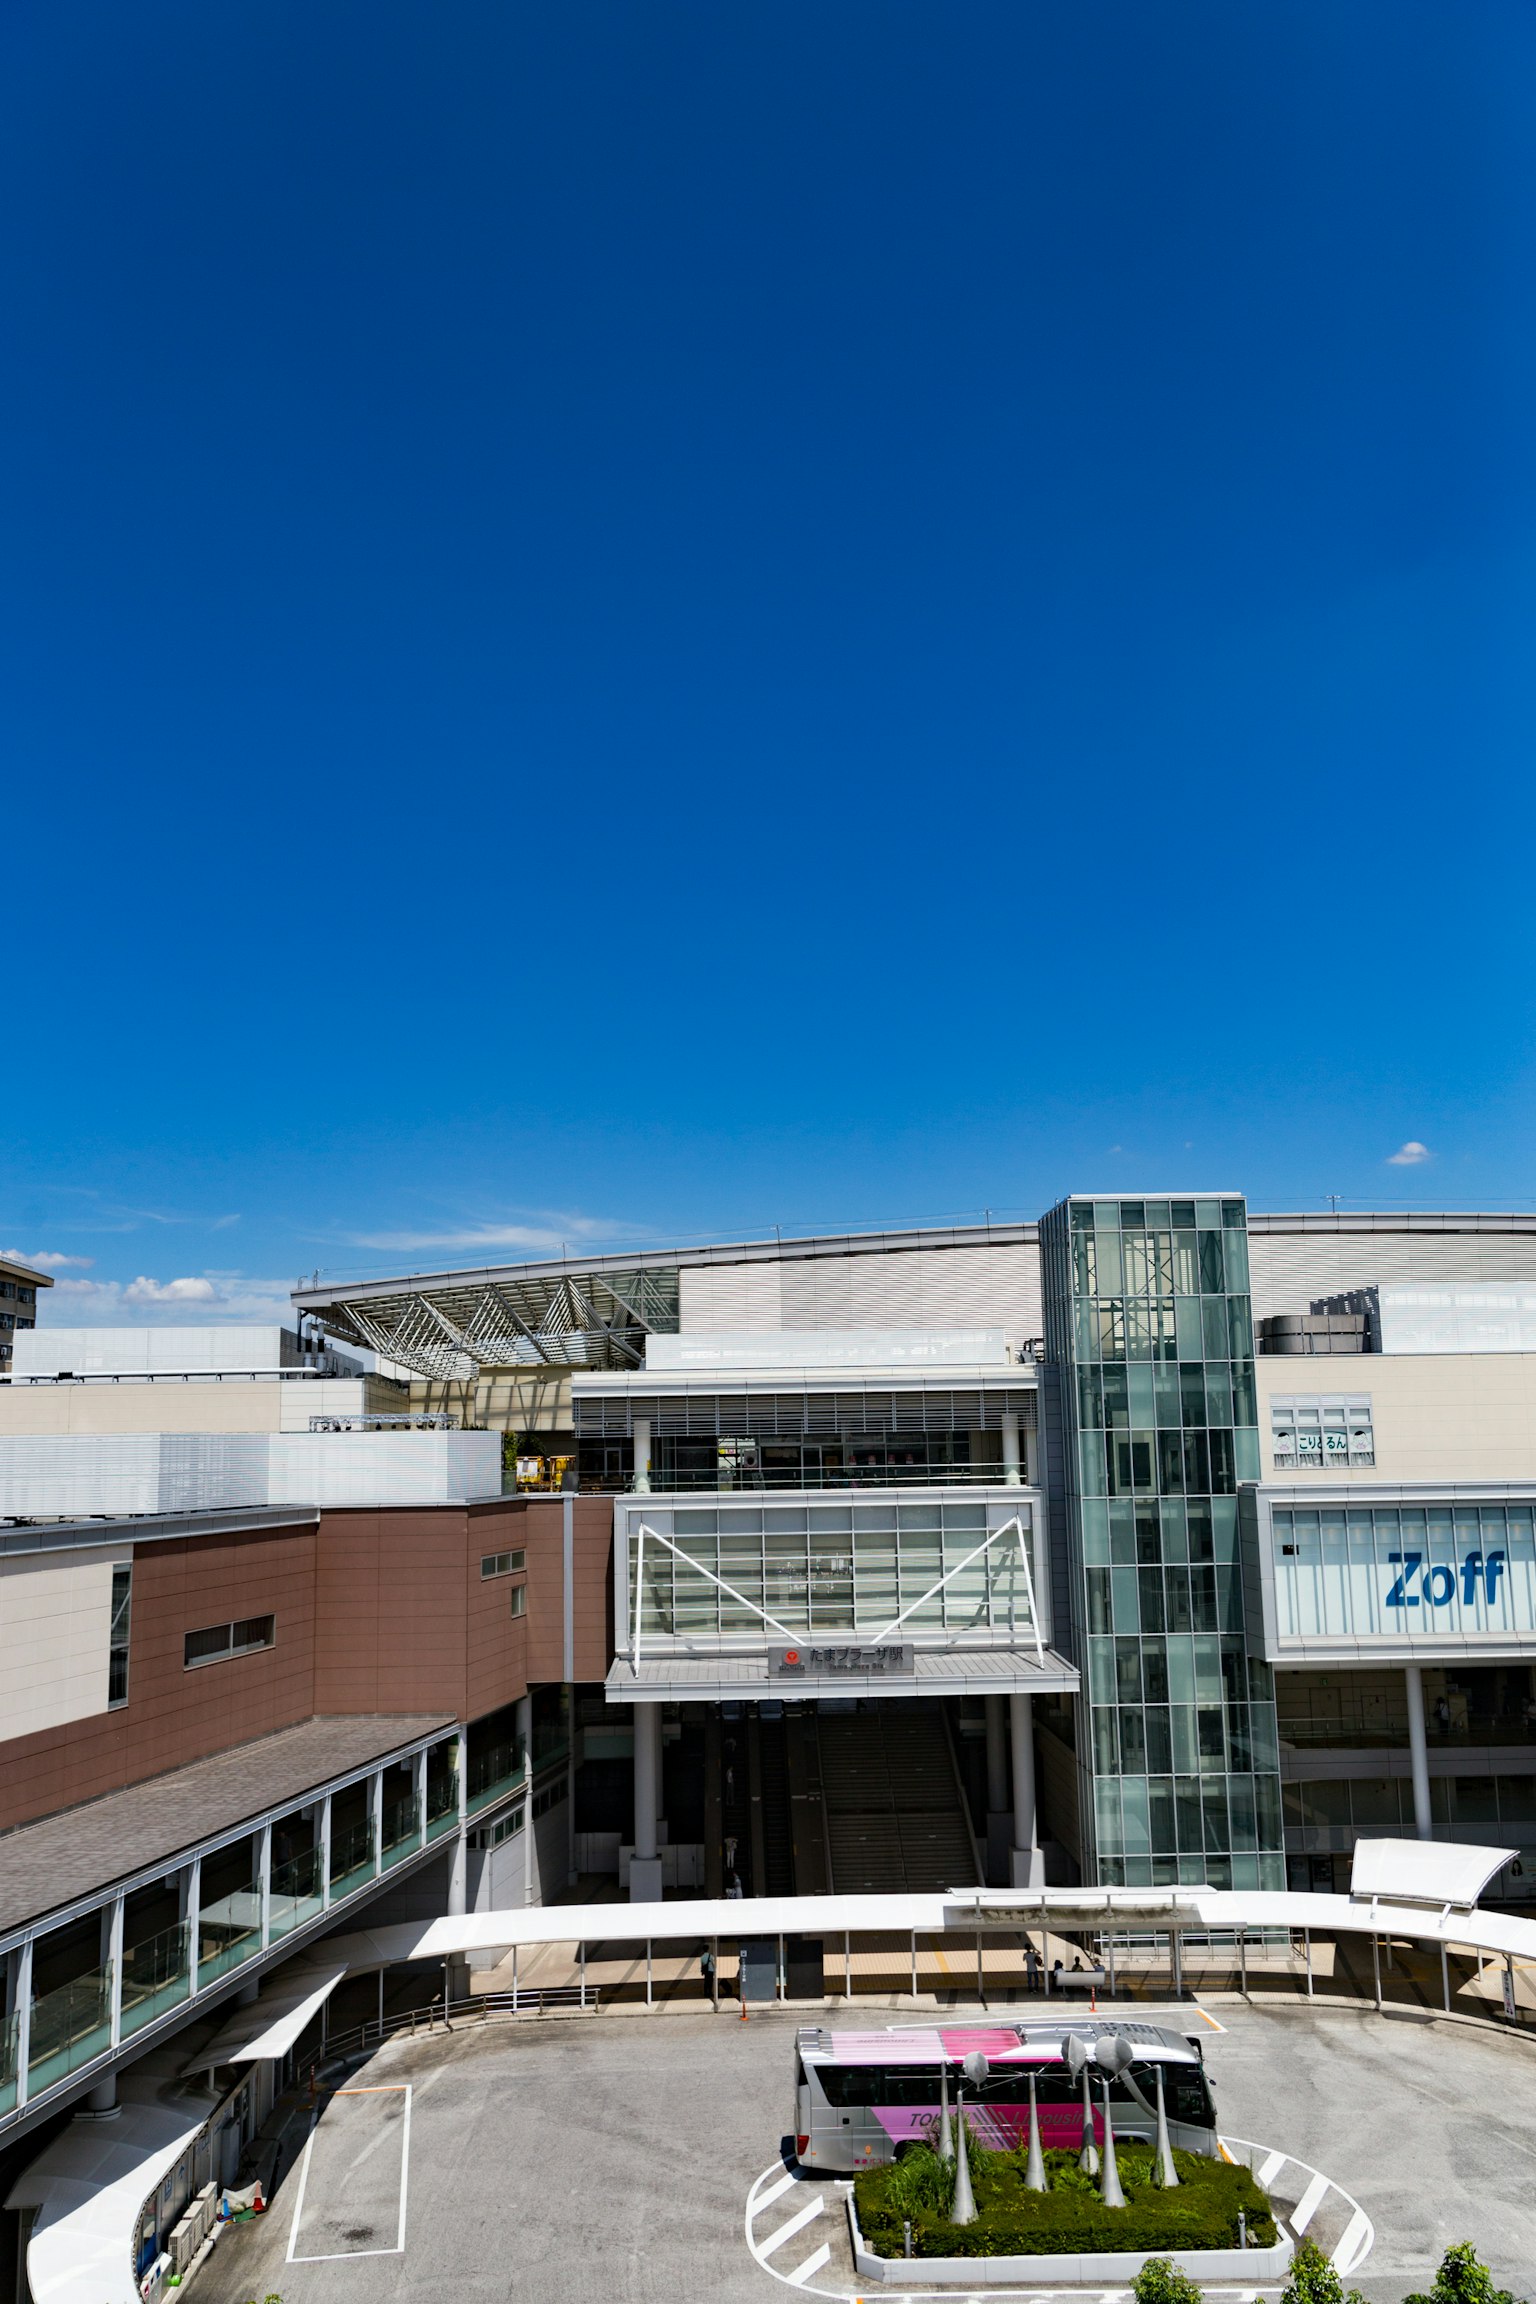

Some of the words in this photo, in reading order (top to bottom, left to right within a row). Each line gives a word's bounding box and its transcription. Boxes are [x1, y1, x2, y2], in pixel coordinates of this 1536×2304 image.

[1386, 1551, 1504, 1607] Zoff
[810, 1646, 903, 1662] たまプラーザ駅
